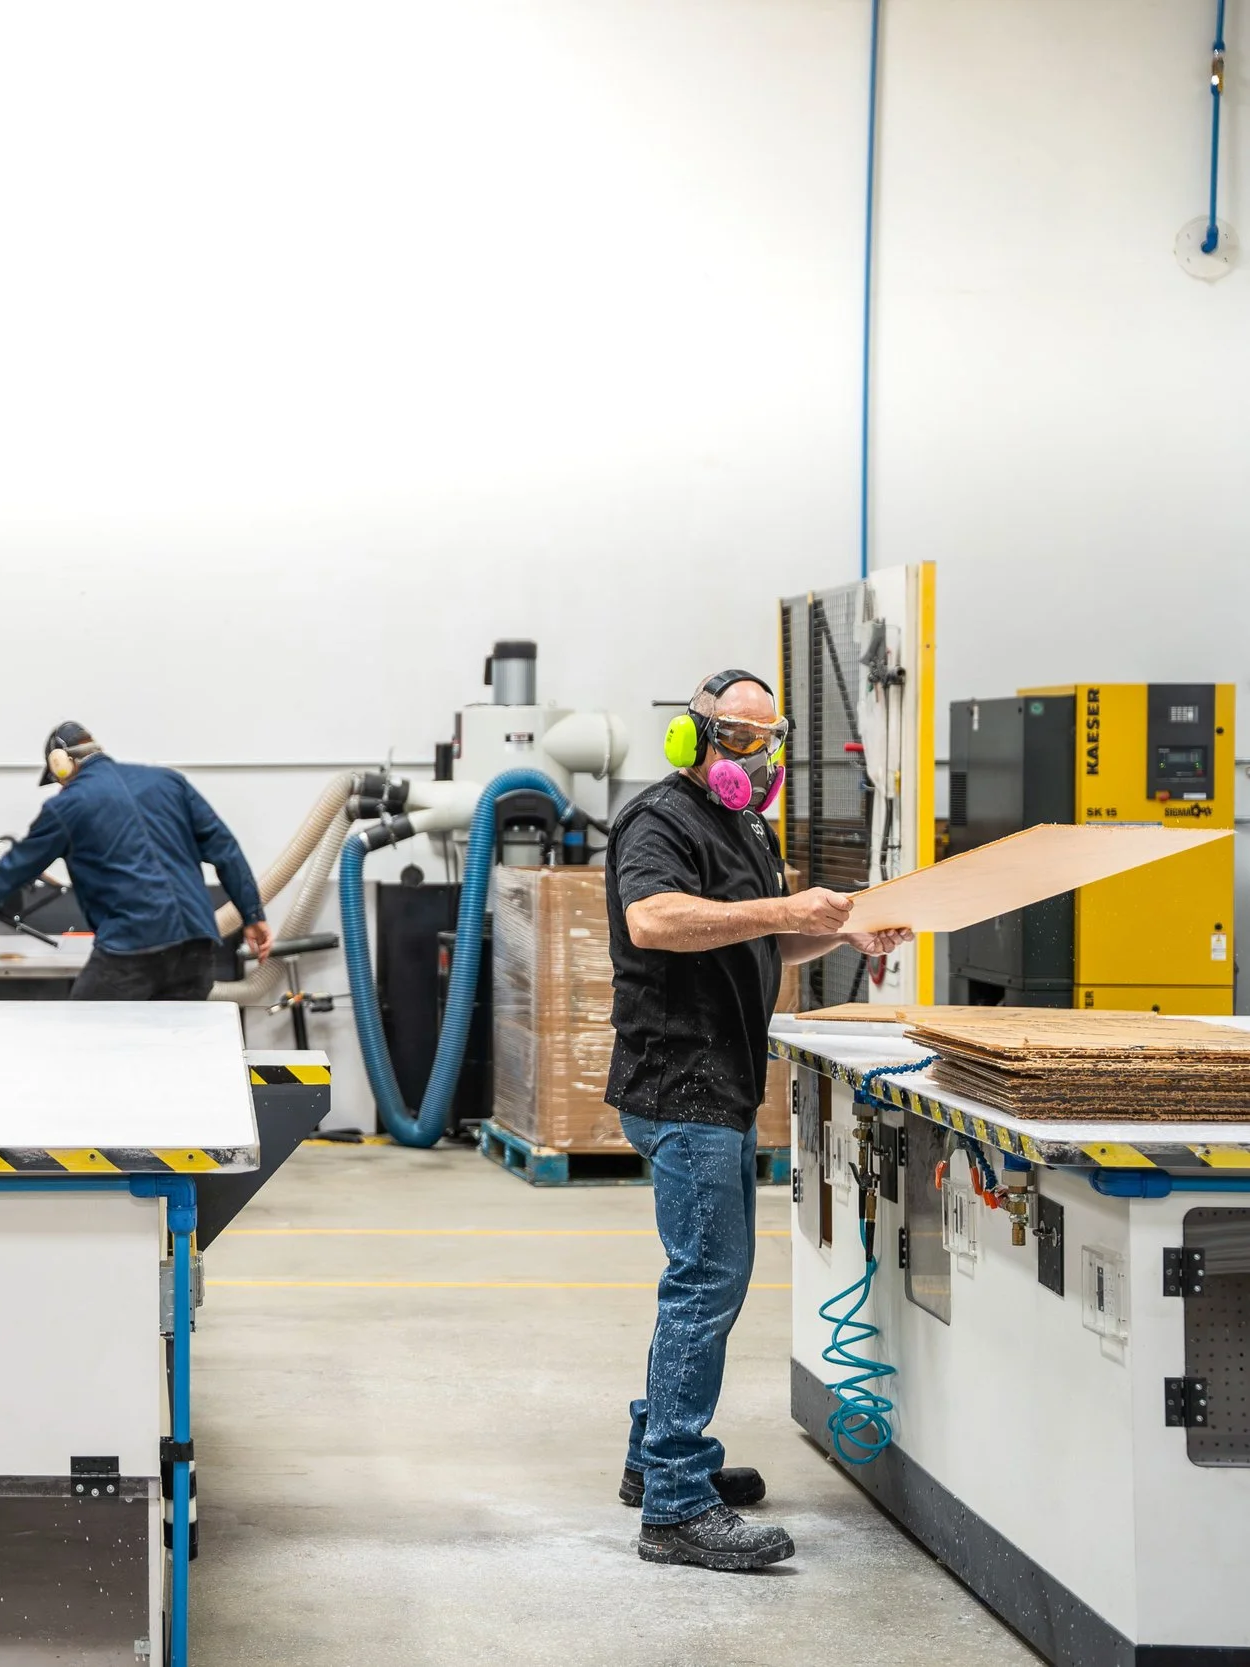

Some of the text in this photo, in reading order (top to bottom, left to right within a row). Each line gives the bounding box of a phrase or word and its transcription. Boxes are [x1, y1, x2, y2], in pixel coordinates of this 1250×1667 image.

[1086, 687, 1100, 776] KAESER
[1086, 807, 1118, 817] SK 15
